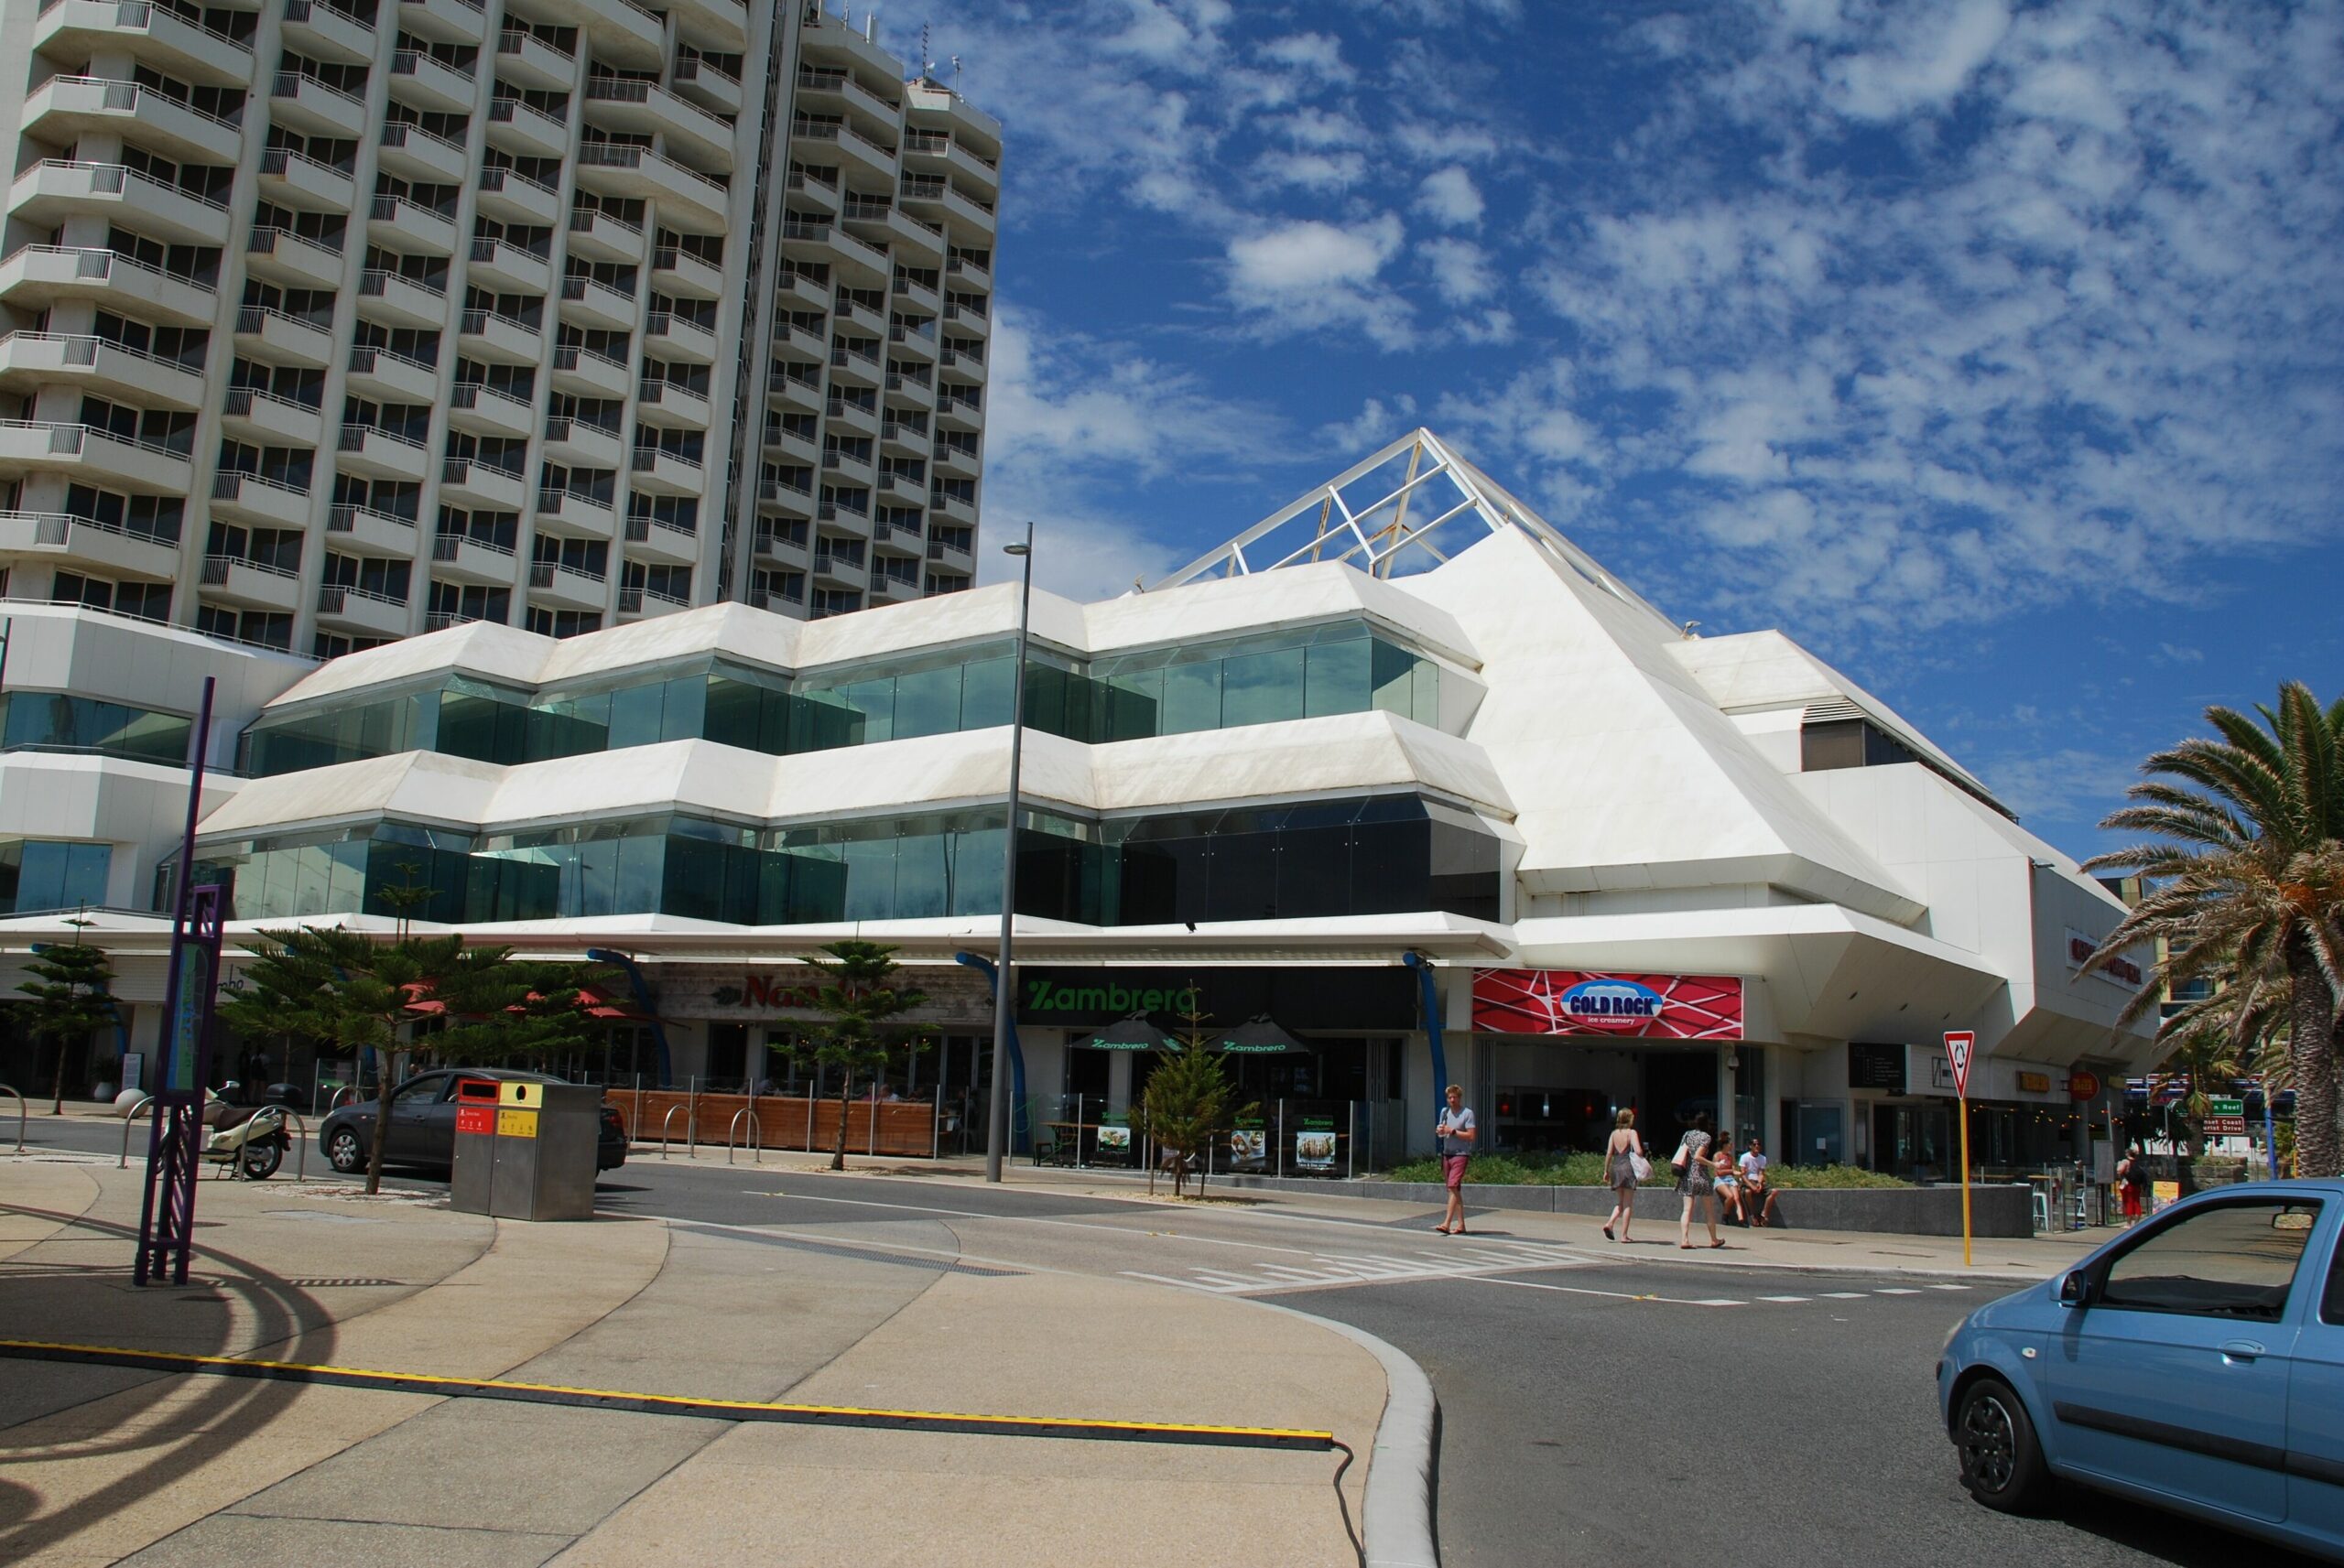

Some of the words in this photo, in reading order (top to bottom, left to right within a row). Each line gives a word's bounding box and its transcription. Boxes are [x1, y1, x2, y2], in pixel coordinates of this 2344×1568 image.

[1027, 980, 1197, 1012] Zambrero
[1570, 996, 1610, 1013] COLD
[1612, 997, 1654, 1015] ROCK
[1600, 1017, 1635, 1025] creamery
[1091, 1038, 1150, 1050] Zambrero
[1222, 1040, 1287, 1053] Zambrero
